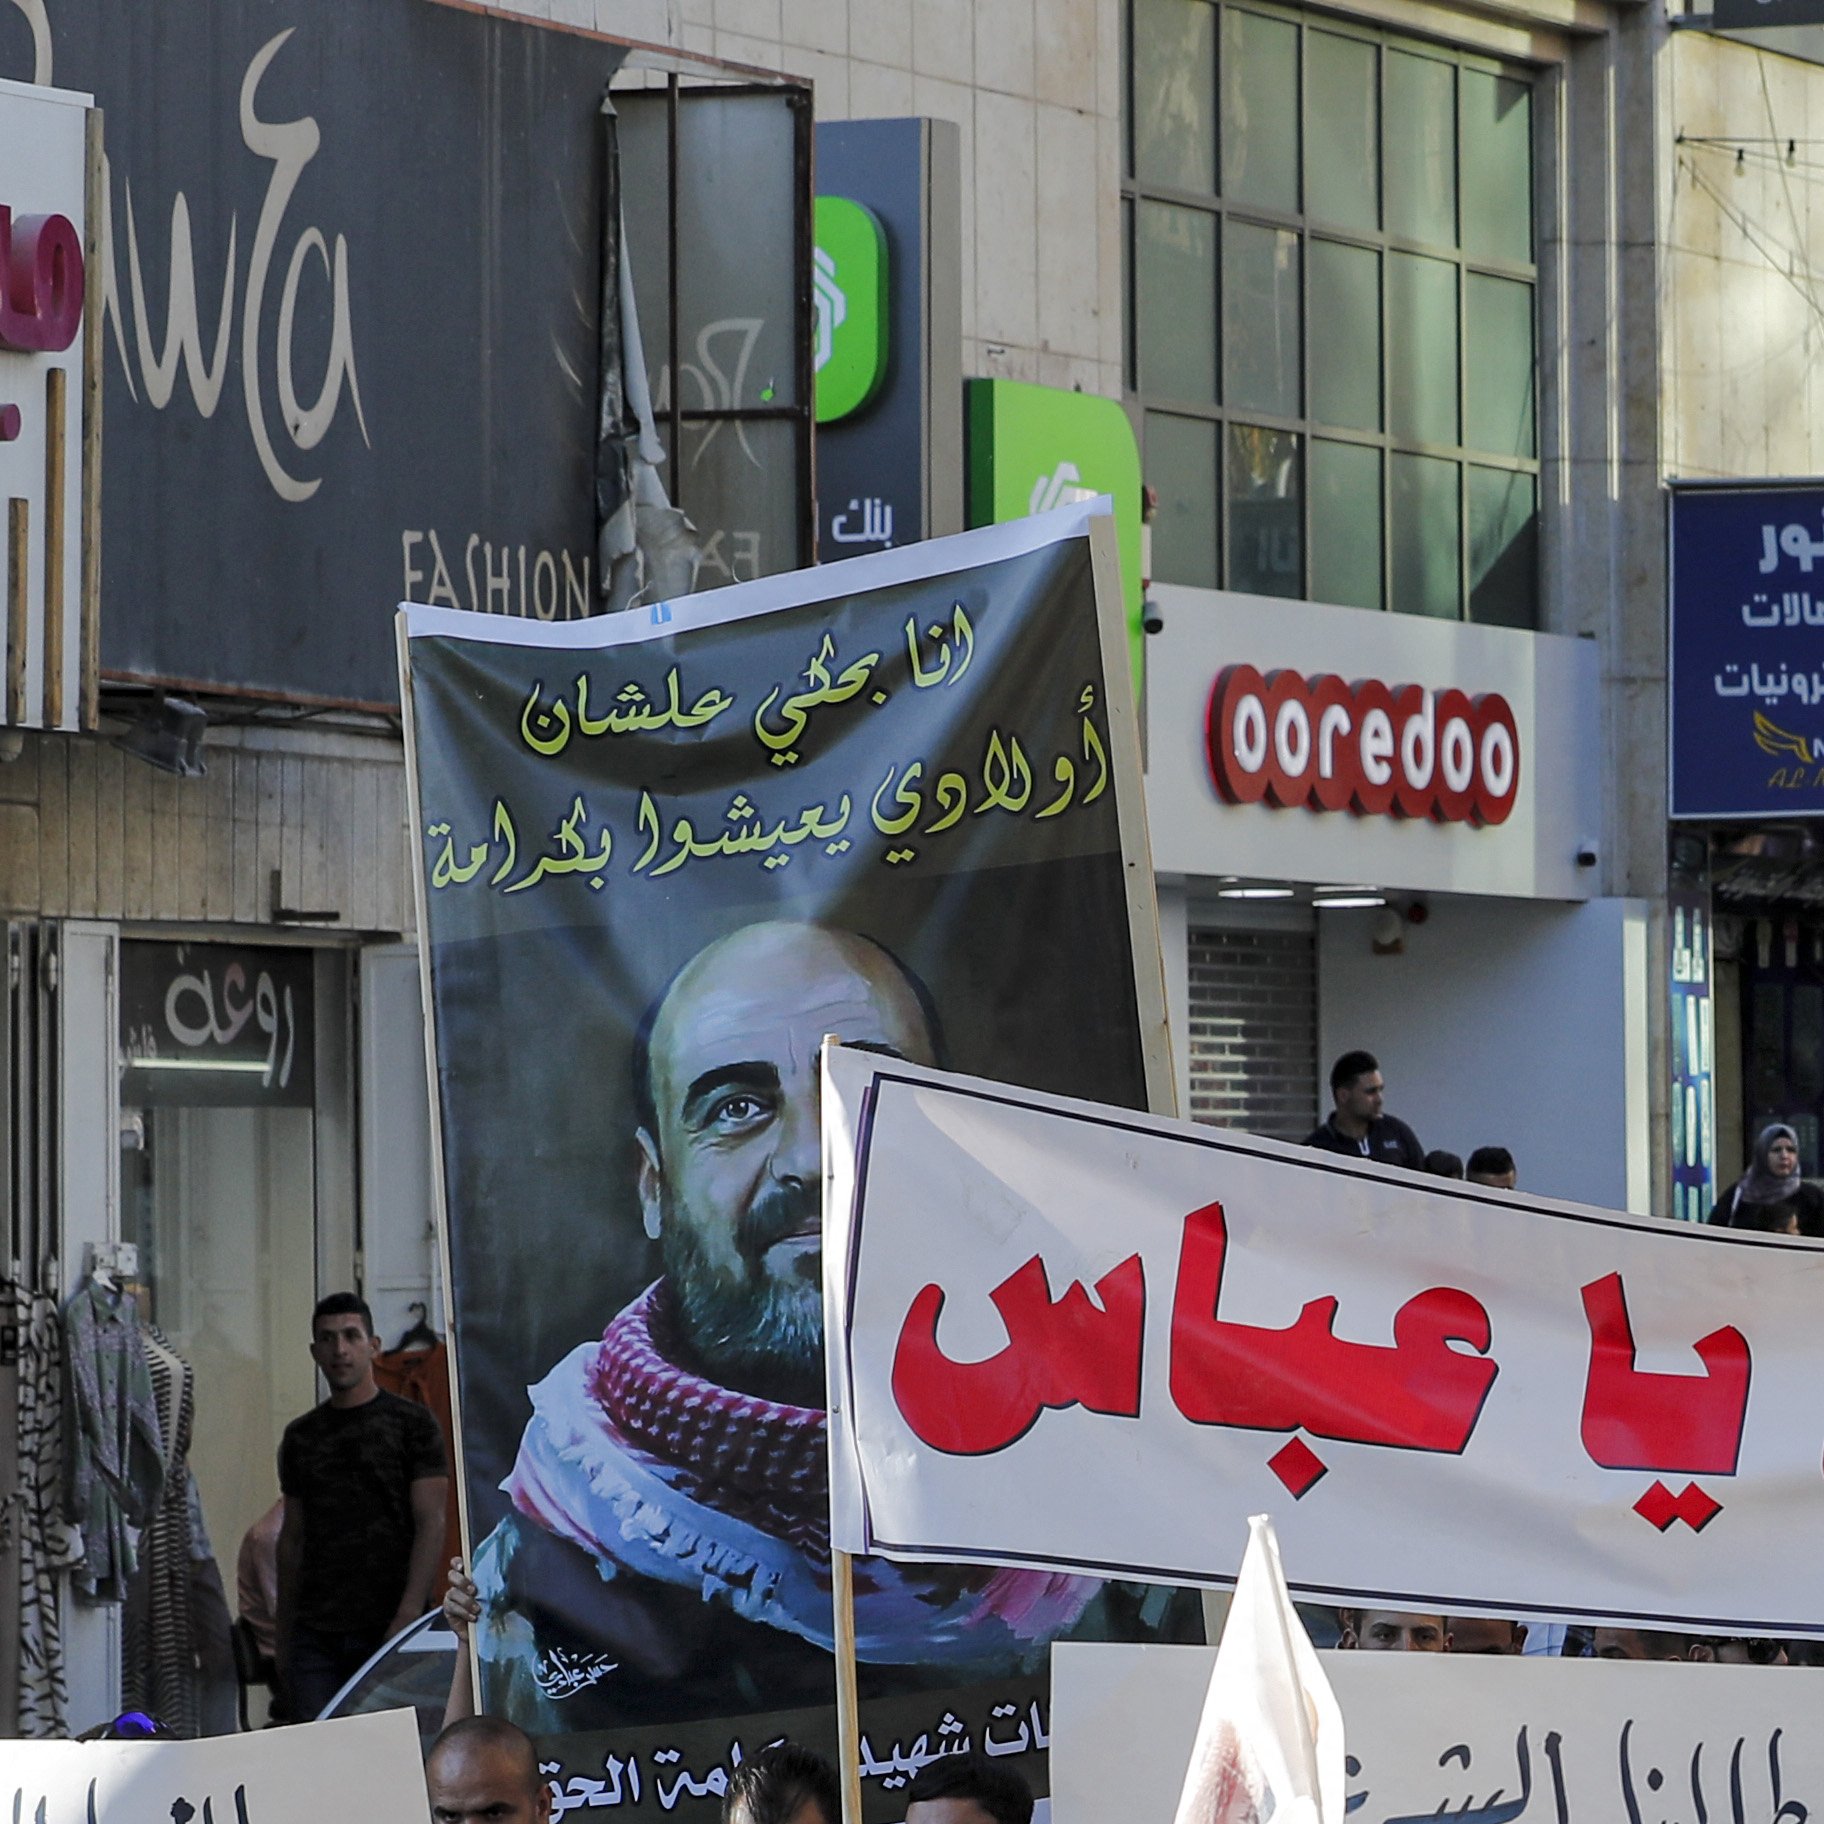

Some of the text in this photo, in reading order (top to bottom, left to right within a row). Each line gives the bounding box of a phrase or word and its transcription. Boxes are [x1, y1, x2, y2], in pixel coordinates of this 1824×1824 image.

[832, 497, 893, 543] بنك
[402, 528, 590, 622] FASHION
[904, 602, 975, 690] انا
[521, 674, 735, 758] علشان
[1232, 688, 1514, 800] ooredoo
[427, 683, 1114, 892] أولادي يعيشوا بكرامة
[891, 1200, 1500, 1502] عباس
[1580, 1270, 1754, 1534] يا
[858, 1711, 972, 1790] شهيد
